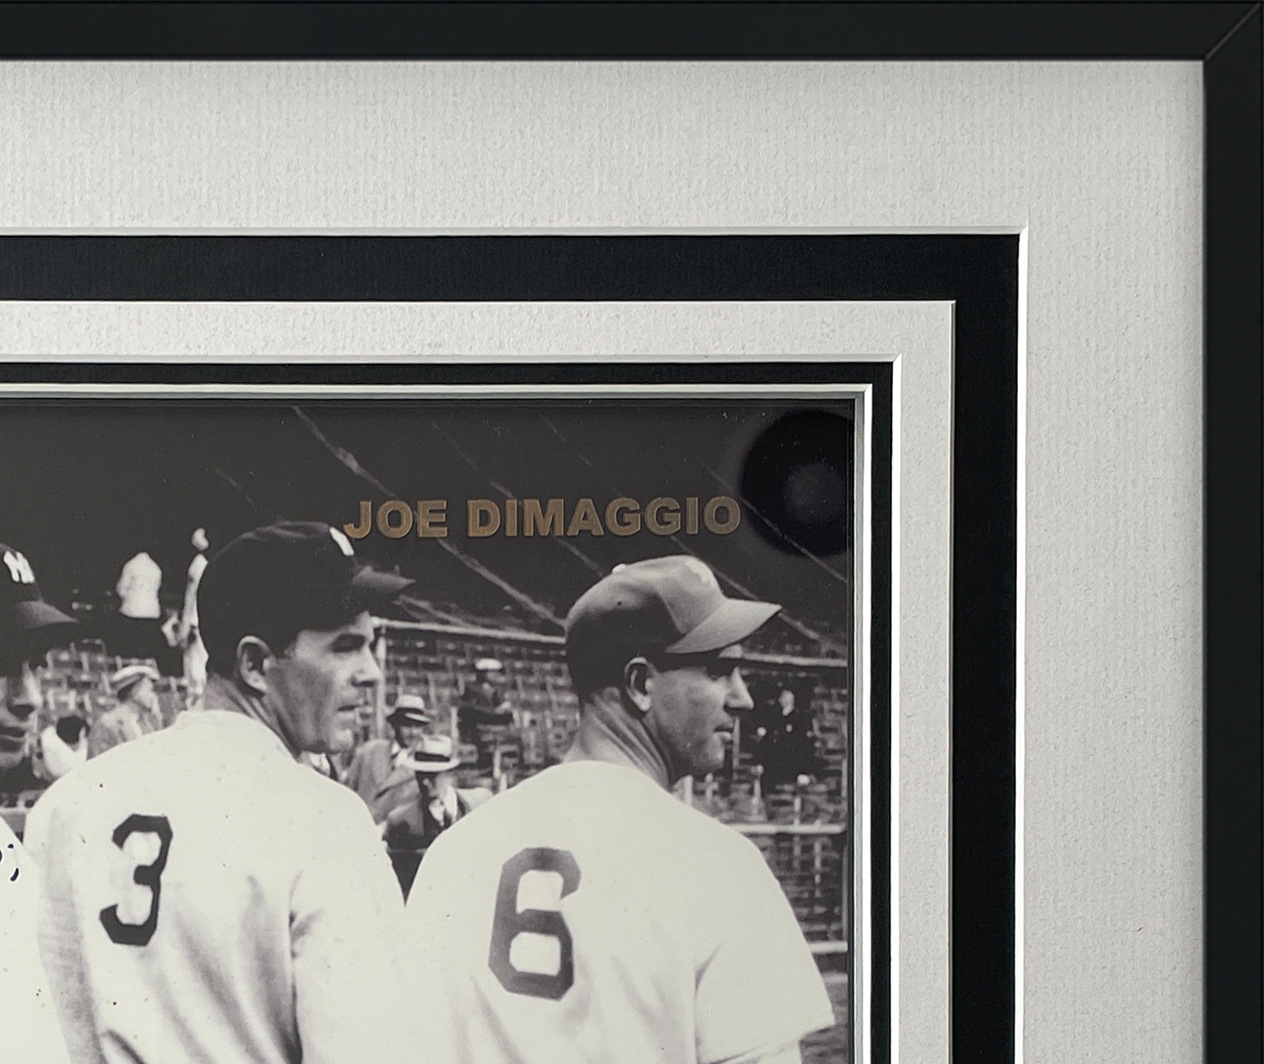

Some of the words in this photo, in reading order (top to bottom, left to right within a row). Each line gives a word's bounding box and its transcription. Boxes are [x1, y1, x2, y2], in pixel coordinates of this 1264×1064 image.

[343, 500, 447, 539] JOE
[468, 498, 741, 539] DIMAGGIO
[99, 814, 172, 946] 3
[488, 847, 581, 999] 6
